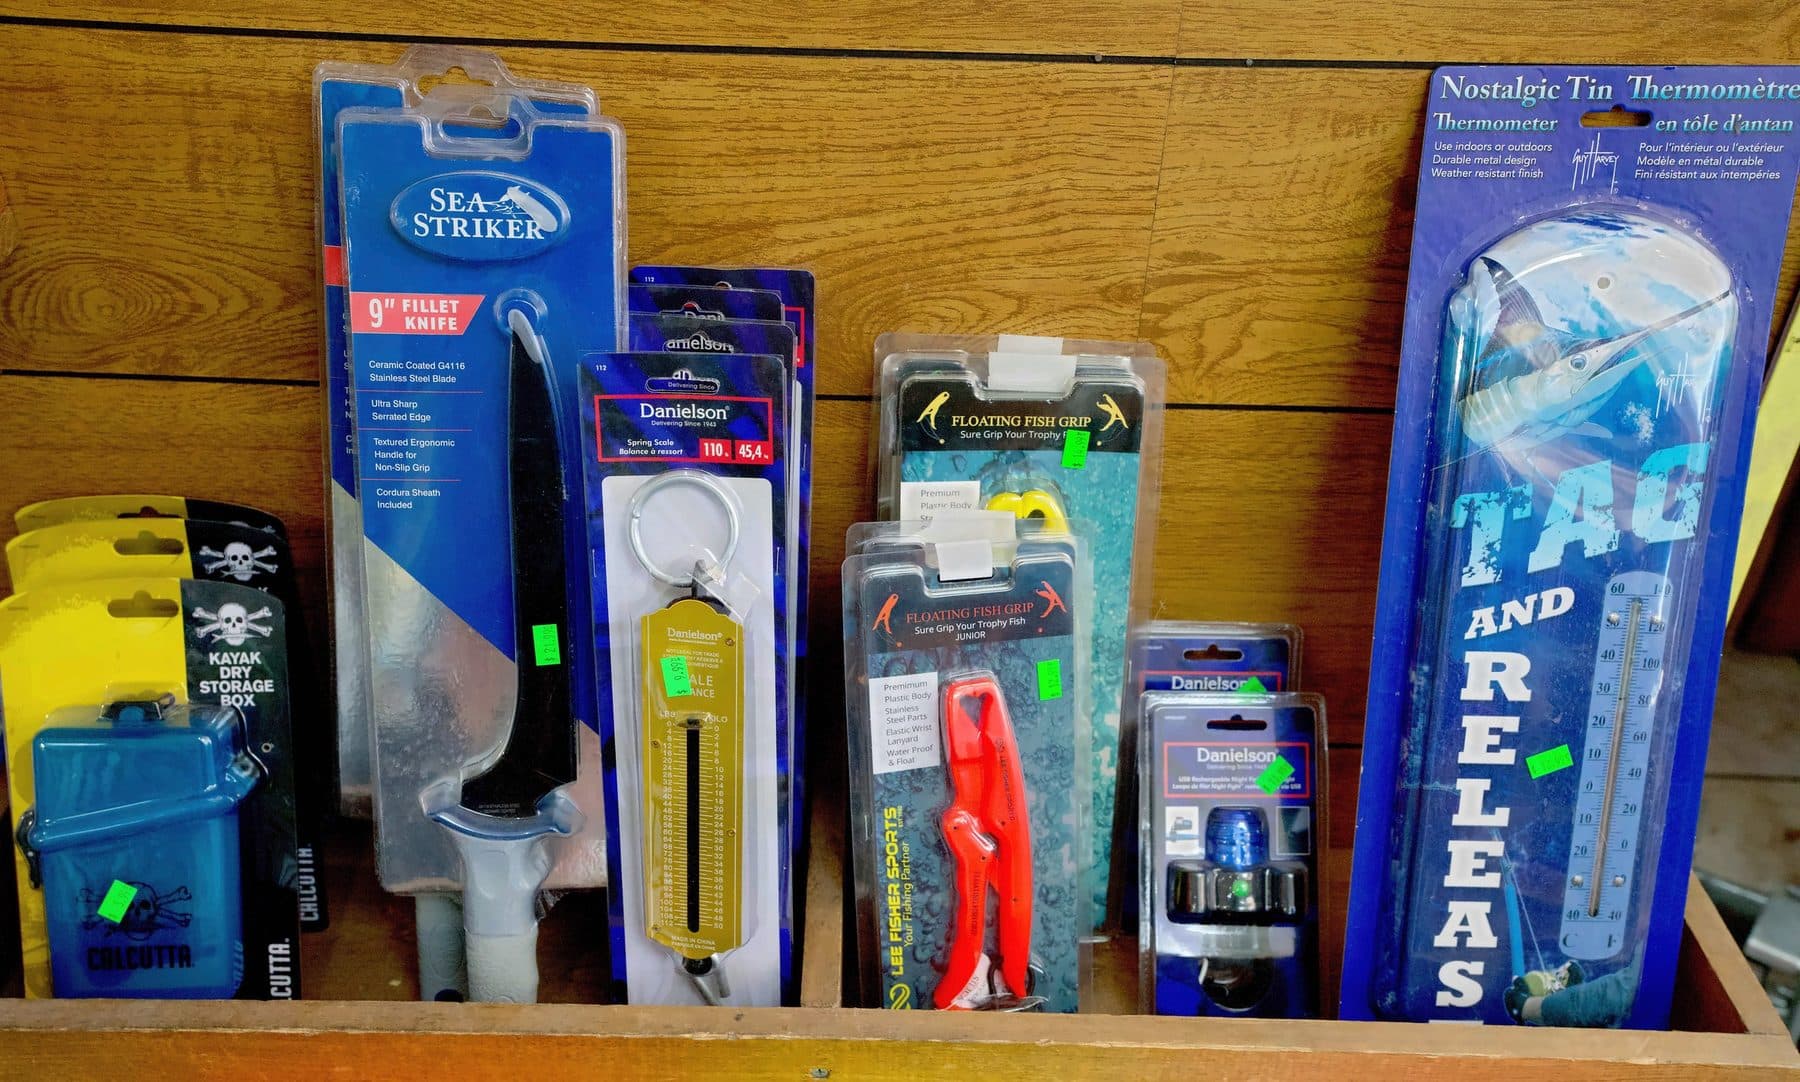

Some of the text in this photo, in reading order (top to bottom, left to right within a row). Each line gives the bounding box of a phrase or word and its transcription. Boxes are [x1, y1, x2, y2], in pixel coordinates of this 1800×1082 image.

[1440, 75, 1613, 108] Nostalgic Tin
[1627, 75, 1800, 101] Thermomètre
[1433, 112, 1558, 131] Thermometer
[1655, 113, 1793, 132] en tôle d'antan
[1434, 142, 1453, 151] Use
[1455, 142, 1492, 151] indoors
[1508, 142, 1553, 152] outdoors
[1639, 143, 1662, 152] Pour
[1665, 143, 1713, 152] l'intérieur
[1732, 143, 1784, 153] l'extérieur
[1433, 155, 1537, 168] Durable metal design
[1637, 156, 1676, 166] Modèle
[1693, 156, 1722, 166] métal
[1724, 156, 1764, 166] durable
[1432, 168, 1544, 178] Weather resistant finish
[1634, 170, 1653, 179] Fini
[1655, 170, 1697, 179] résistant
[1720, 170, 1781, 181] intempéries
[430, 187, 488, 213] SEA
[414, 213, 544, 240] STRIKER
[402, 299, 459, 314] FILLET
[369, 298, 394, 328] 9"
[405, 316, 457, 331] KNIFE
[369, 360, 465, 370] Ceramic Coated G4116
[370, 374, 456, 383] Stainless Steel Blade
[393, 400, 418, 409] Sharp
[640, 403, 728, 419] Danielson
[372, 412, 431, 422] Serrated Edge
[952, 415, 1092, 428] FLOATING FISH GRIP
[960, 430, 982, 439] Sure
[983, 430, 1003, 440] Grip
[1005, 430, 1026, 439] Your
[1028, 430, 1060, 440] Trophy
[373, 437, 455, 448] Textured Ergonomic
[627, 439, 652, 447] Spring
[374, 450, 417, 459] Handle for
[704, 442, 723, 457] 110
[739, 444, 762, 460] 45,4
[375, 463, 430, 473] Non-Slip Grip
[376, 488, 441, 497] Cordura Sheath
[377, 501, 413, 509] Included
[1450, 441, 1710, 588] TAG
[1611, 583, 1624, 594] 60
[906, 602, 1034, 623] FLOATING FISH GRIP
[1464, 587, 1575, 640] AND
[914, 617, 1026, 634] Sure Grip Your Trophy Fish
[667, 627, 718, 640] Danielson
[955, 631, 986, 640] JUNIOR
[209, 652, 262, 665] KAYAK
[1601, 649, 1615, 660] 40
[1642, 657, 1660, 669] 100
[219, 666, 252, 679] DRY
[199, 680, 275, 693] STORAGE
[1598, 683, 1610, 693] 30
[220, 694, 256, 707] BOX
[884, 692, 932, 703] Plastic Body
[885, 705, 920, 715] Stainless
[886, 716, 906, 724] Steel
[1592, 715, 1606, 726] 20
[886, 724, 932, 736] Elastic Wrist
[888, 735, 919, 745] Lanyard
[1633, 732, 1647, 742] 60
[887, 744, 934, 757] Water Proof
[1197, 747, 1276, 762] Danielson
[1588, 748, 1601, 759] 10
[1628, 768, 1642, 778] 40
[1586, 782, 1593, 792] 0
[1622, 804, 1637, 814] 20
[1579, 813, 1592, 823] 10
[1428, 651, 1531, 1024] RELEAS
[1621, 840, 1628, 849] 0
[1574, 846, 1587, 856] 20
[884, 806, 904, 976] LEE FISHER SPORTS
[901, 842, 914, 947] Your Fishing Partner
[1566, 910, 1579, 920] 40
[1608, 910, 1622, 920] 40
[1562, 934, 1578, 948] C
